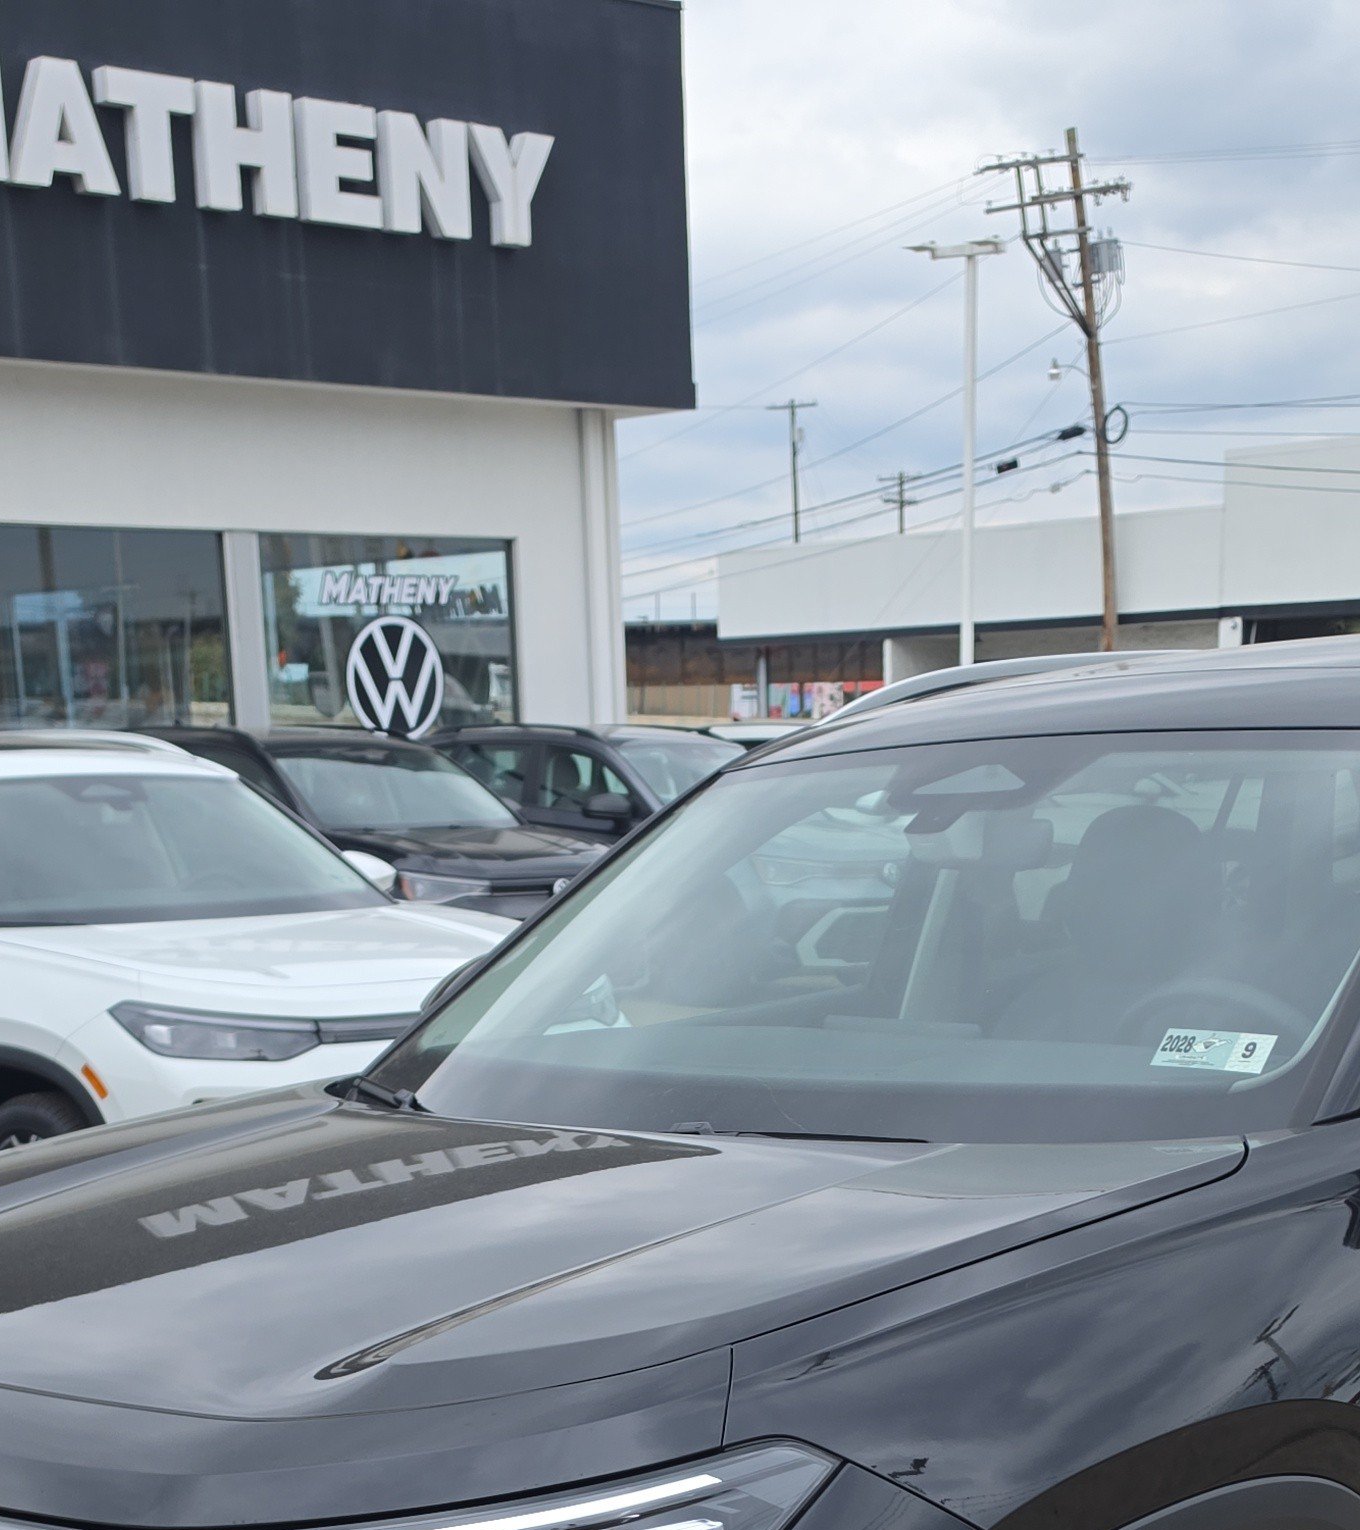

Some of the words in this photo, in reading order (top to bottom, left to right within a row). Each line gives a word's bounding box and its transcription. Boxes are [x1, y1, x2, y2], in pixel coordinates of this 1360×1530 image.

[320, 570, 458, 606] MATHENY
[346, 616, 444, 740] VW
[1159, 1034, 1197, 1053] 2028
[1241, 1041, 1257, 1059] 9
